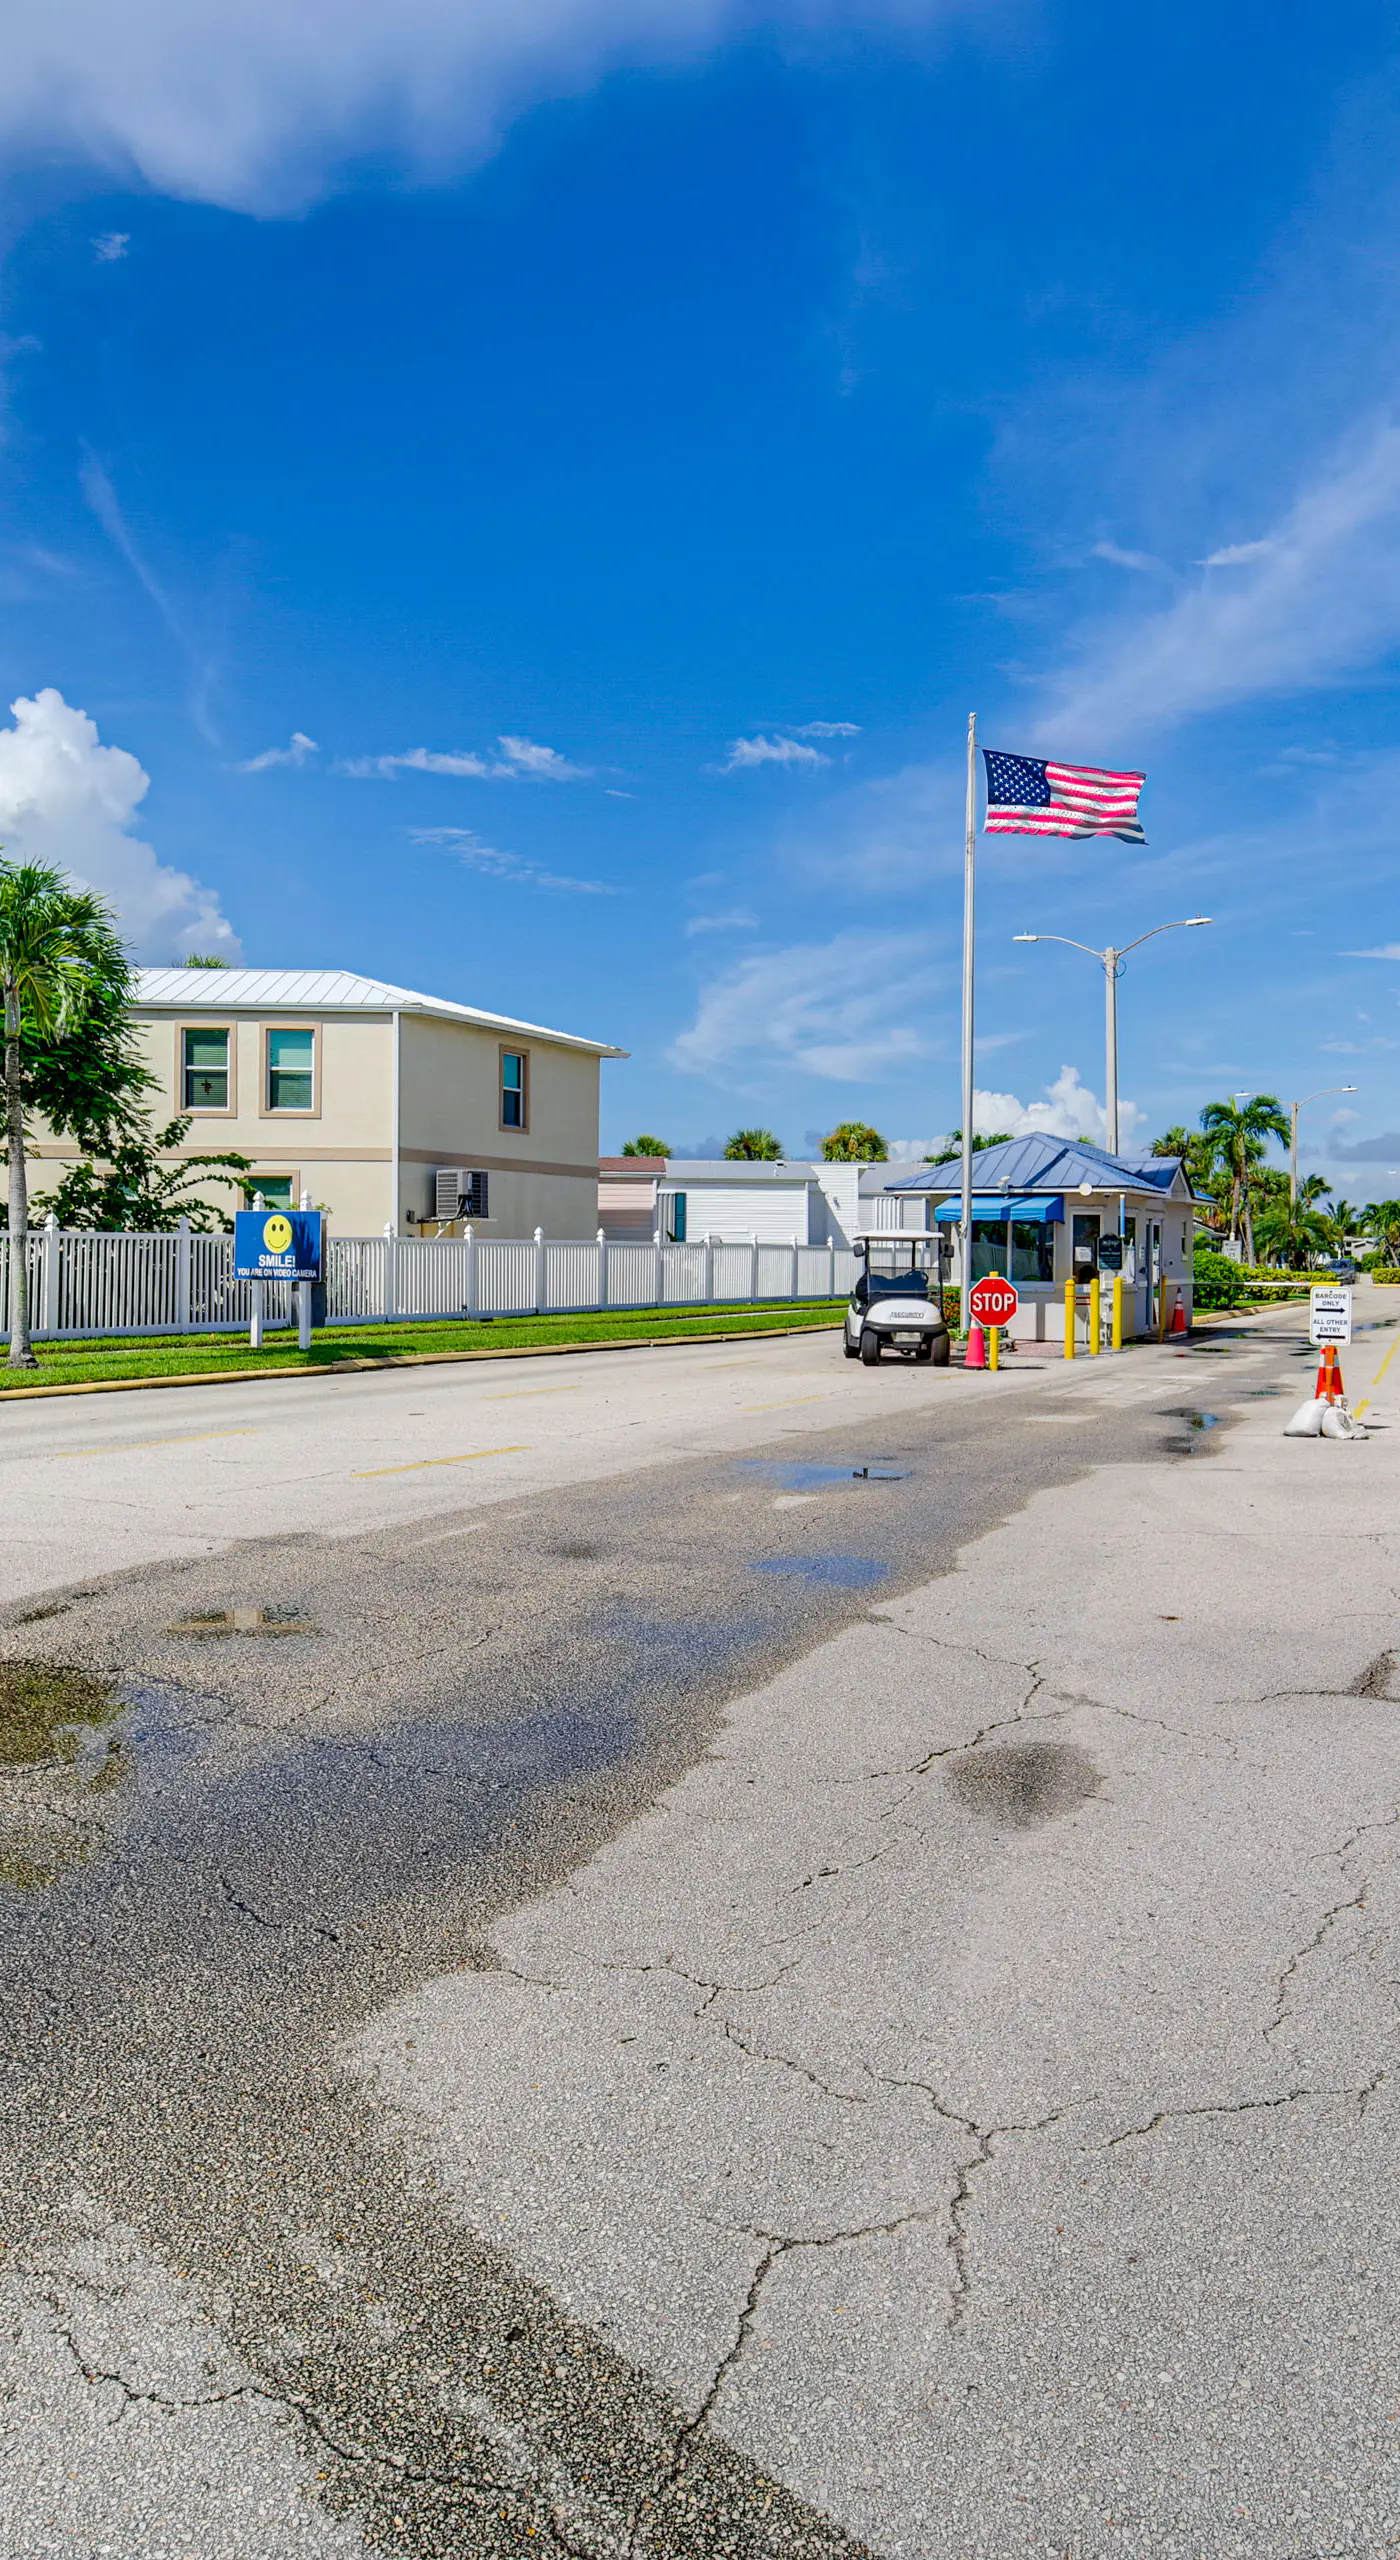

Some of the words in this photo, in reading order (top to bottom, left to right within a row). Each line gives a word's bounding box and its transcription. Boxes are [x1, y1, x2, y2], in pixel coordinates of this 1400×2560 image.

[258, 1254, 296, 1268] SMILE!
[237, 1267, 250, 1276] YOU
[251, 1268, 263, 1277] ARE
[263, 1268, 273, 1277] ON
[273, 1268, 291, 1277] VIDEO
[291, 1268, 317, 1278] CAMERA
[972, 1292, 1014, 1312] STOP
